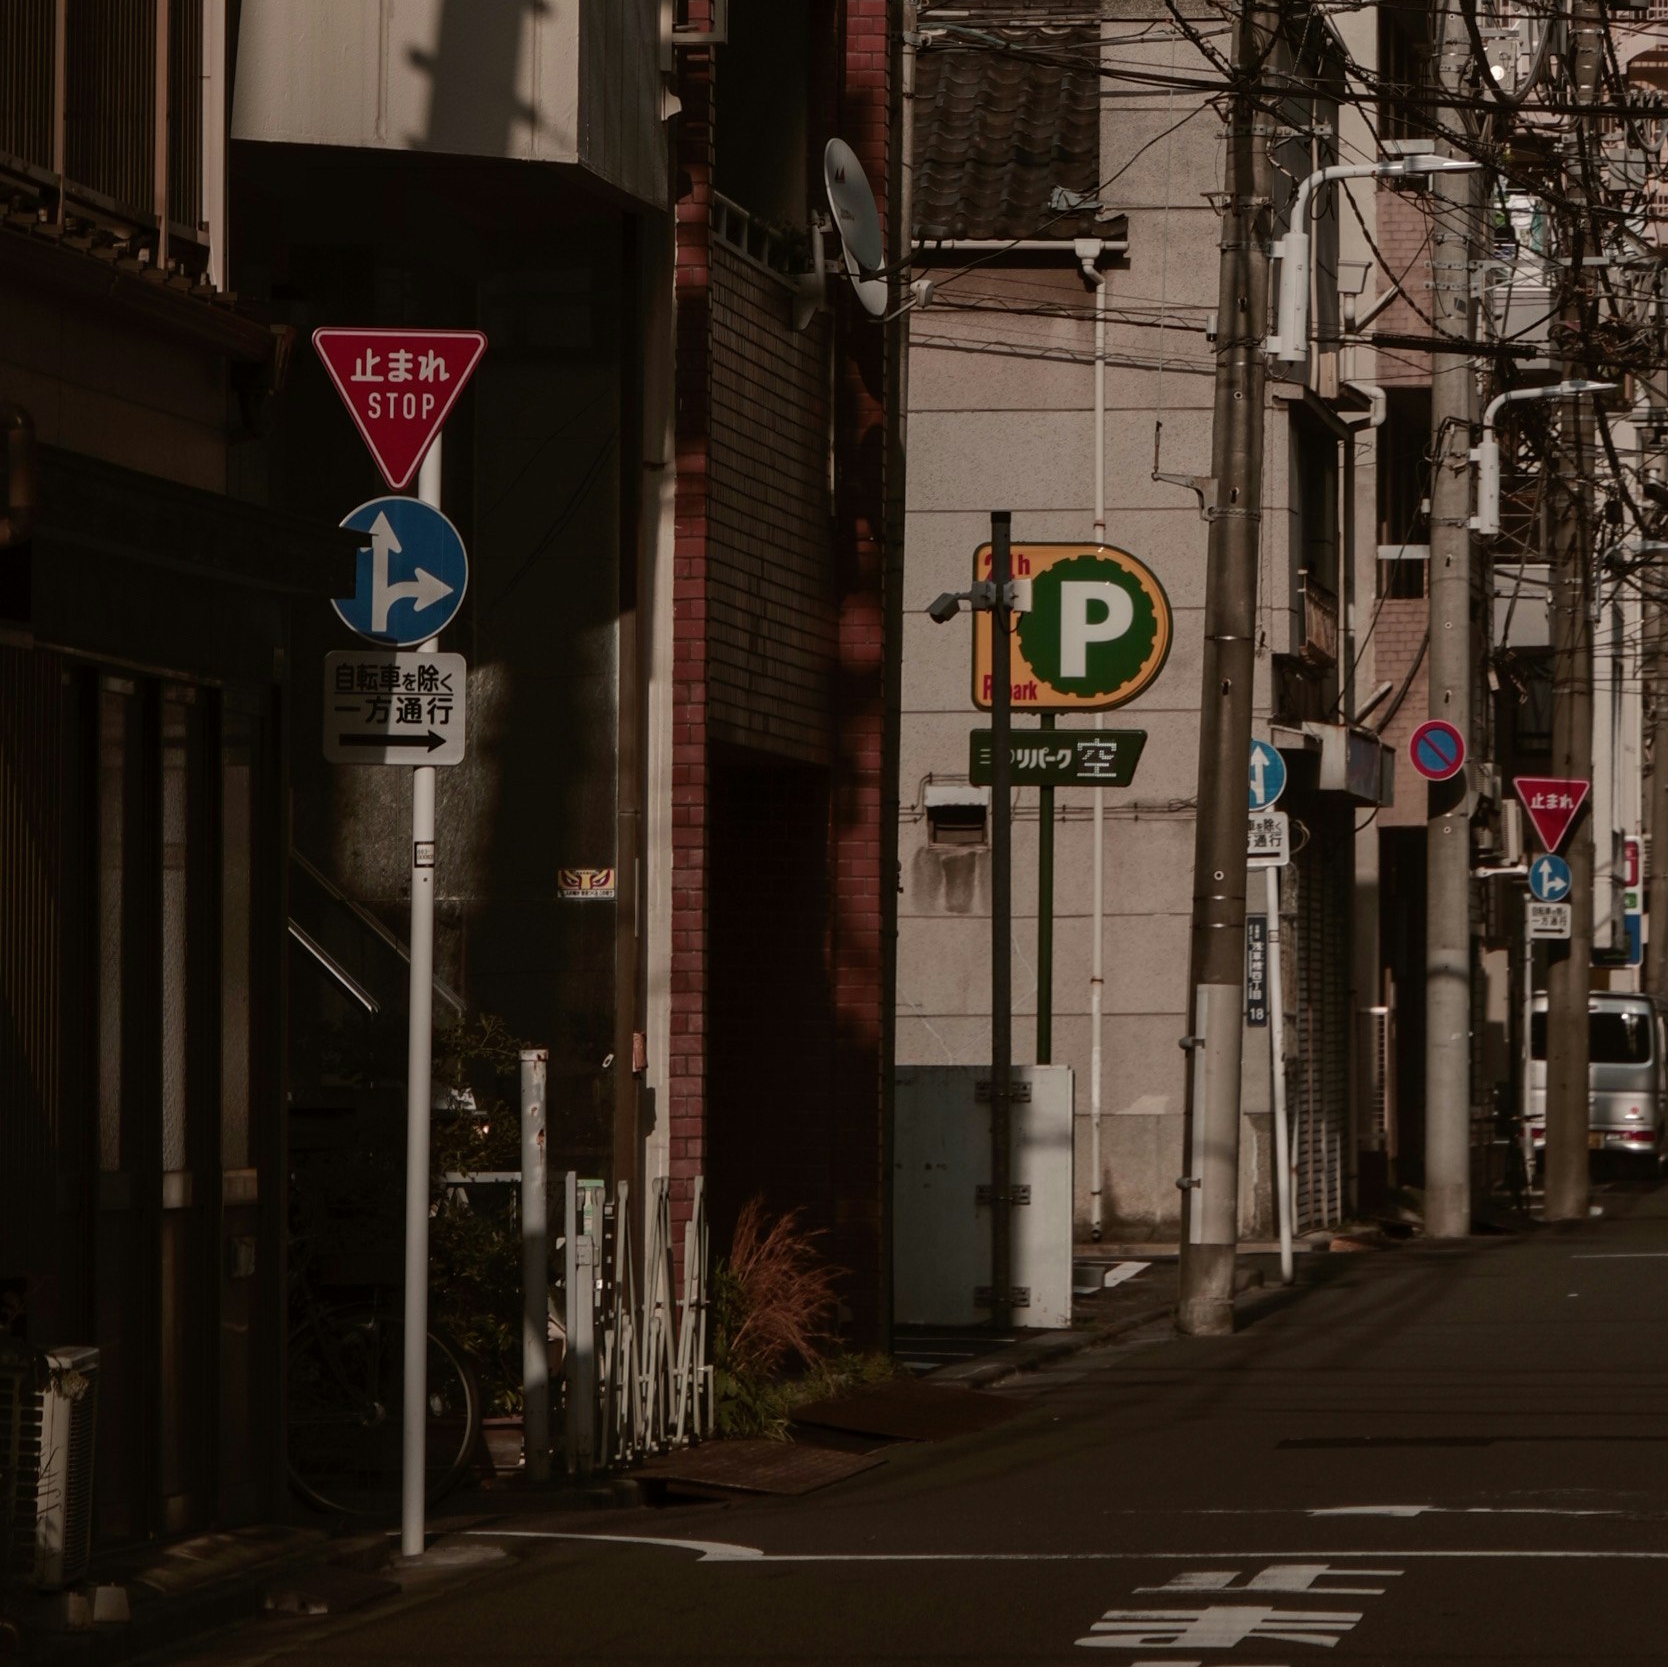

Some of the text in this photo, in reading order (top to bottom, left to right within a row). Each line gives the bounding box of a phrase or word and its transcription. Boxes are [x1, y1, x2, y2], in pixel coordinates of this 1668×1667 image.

[350, 348, 450, 382] 止まれ
[368, 392, 435, 420] STOP
[1059, 580, 1135, 678] P
[334, 664, 454, 693] 自転車を除く
[983, 674, 1038, 701] Rark
[334, 697, 454, 725] 一方通行
[1076, 737, 1117, 778] 空
[1530, 792, 1574, 810] 止まれ
[1249, 1007, 1265, 1021] 18
